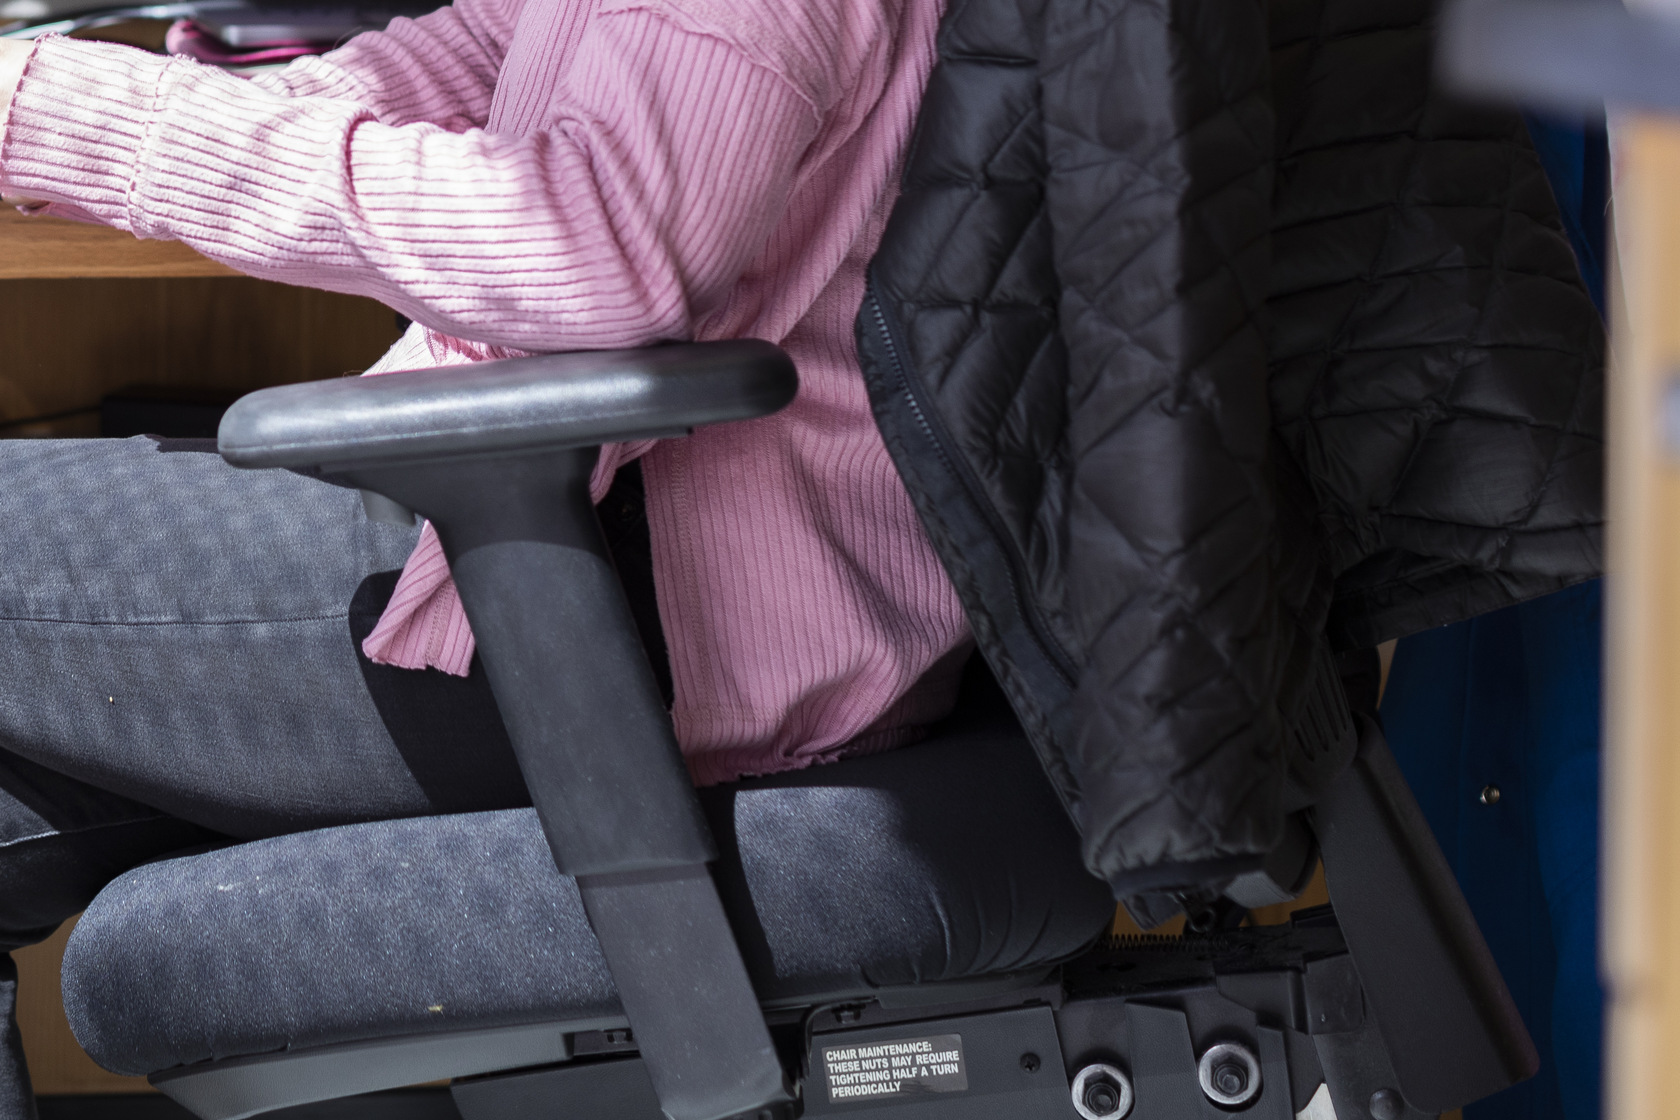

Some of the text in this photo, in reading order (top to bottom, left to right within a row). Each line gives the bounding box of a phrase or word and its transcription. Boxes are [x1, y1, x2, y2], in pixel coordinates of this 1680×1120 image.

[826, 1041, 932, 1062] CHAIR MAINTENANCE:
[827, 1050, 960, 1074] THESE NUTS MAY REQUIRE
[829, 1063, 959, 1086] TIGHTENING HALF A TURN
[831, 1081, 901, 1098] PERIODICALLY
